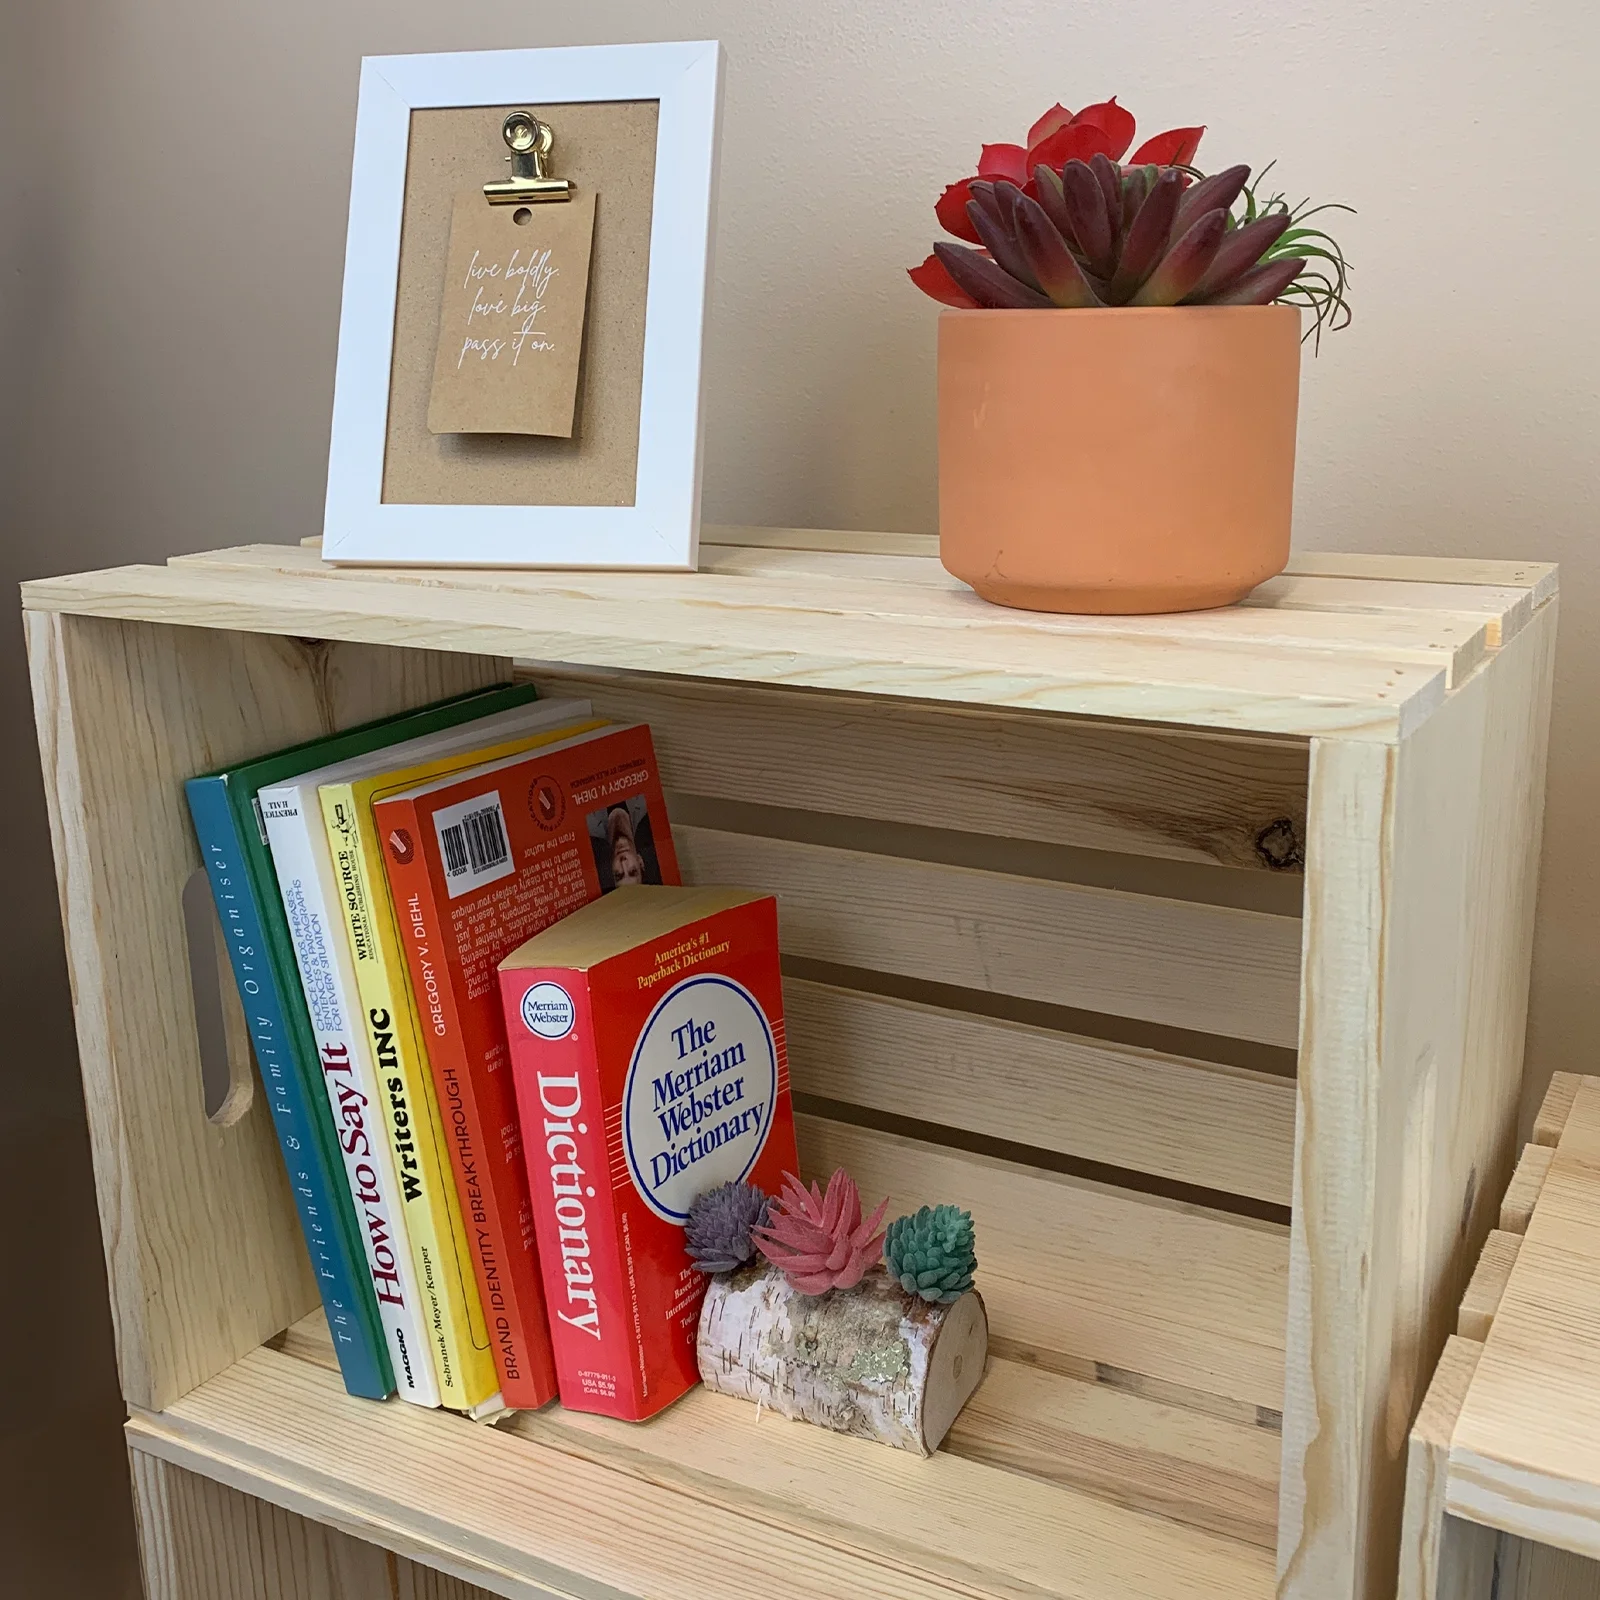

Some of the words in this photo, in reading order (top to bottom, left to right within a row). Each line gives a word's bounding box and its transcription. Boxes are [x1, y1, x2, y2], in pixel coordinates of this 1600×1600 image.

[464, 250, 502, 288] live
[505, 250, 560, 298] boldly.
[468, 286, 508, 326] love
[510, 286, 546, 328] big.
[458, 336, 506, 370] pass
[512, 324, 546, 366] it
[531, 339, 554, 352] on.
[598, 785, 607, 795] V.
[609, 770, 648, 792] GREGORY
[268, 801, 288, 809] HALL
[572, 787, 597, 804] DIEHL
[264, 808, 298, 818] PRENTICE
[546, 838, 557, 848] the
[558, 831, 574, 843] From
[524, 843, 544, 857] Author
[553, 855, 560, 863] to
[561, 848, 578, 860] value
[520, 863, 540, 878] world.
[541, 858, 552, 868] the
[556, 858, 580, 873] identity
[338, 851, 355, 910] SOURCE
[518, 874, 540, 889] clearly
[541, 868, 555, 880] that
[557, 868, 582, 884] starting
[354, 874, 364, 911] PUBLISHING
[492, 884, 517, 901] displays
[571, 878, 585, 890] lead
[477, 894, 490, 908] your
[498, 898, 510, 910] you
[534, 888, 559, 906] growing
[212, 844, 260, 995] Organiser
[286, 888, 302, 937] PHRASES,
[292, 879, 315, 954] PARAGRAPHS
[408, 892, 426, 940] DIEHL
[451, 903, 475, 919] unique
[468, 907, 494, 924] deserve
[548, 914, 554, 923] at
[453, 920, 462, 931] an
[474, 923, 485, 934] are
[490, 918, 496, 927] or
[526, 919, 545, 933] higher
[310, 914, 328, 967] SITUATION
[351, 913, 366, 959] WRITE
[362, 916, 373, 959] EDUCATIONAL
[456, 928, 469, 943] just
[475, 927, 503, 946] Whether
[492, 940, 499, 950] by
[419, 942, 432, 959] V.
[458, 939, 471, 953] you
[460, 946, 489, 965] meeting
[654, 938, 698, 966] America's
[698, 932, 710, 946] #1
[298, 940, 313, 983] WORDS,
[310, 957, 319, 966] &
[463, 964, 475, 978] sell
[479, 959, 486, 968] to
[636, 960, 681, 990] Paperback
[683, 940, 730, 970] Dictionary
[323, 971, 337, 1004] EVERY
[465, 971, 487, 989] brand.
[313, 969, 333, 1030] SENTENCES
[420, 960, 446, 1036] GREGORY
[467, 982, 490, 999] strong
[308, 987, 324, 1031] CHOICE
[528, 1000, 568, 1011] Merriam
[331, 1008, 342, 1030] FOR
[530, 1012, 568, 1023] Webster
[370, 1008, 398, 1069] INC
[670, 1017, 716, 1060] The
[257, 1016, 292, 1114] Family
[322, 1042, 352, 1077] It
[652, 1042, 746, 1112] Merriam
[335, 1079, 371, 1156] Say
[658, 1076, 744, 1142] Webster
[286, 1136, 300, 1150] &
[388, 1077, 422, 1203] Writers
[443, 1068, 486, 1222] BREAKTHROUGH
[650, 1102, 764, 1190] Dictionary
[356, 1164, 380, 1204] to
[537, 1071, 601, 1341] Dictionary
[298, 1172, 335, 1279] Friends
[365, 1207, 405, 1310] How
[476, 1228, 505, 1310] IDENTITY
[679, 1268, 690, 1280] The
[674, 1278, 691, 1298] Based
[692, 1274, 700, 1284] on
[333, 1300, 352, 1343] The
[422, 1246, 454, 1388] Sebranek/Meyer/Kemper
[496, 1316, 520, 1380] BRAND
[396, 1328, 414, 1388] MAGGIO
